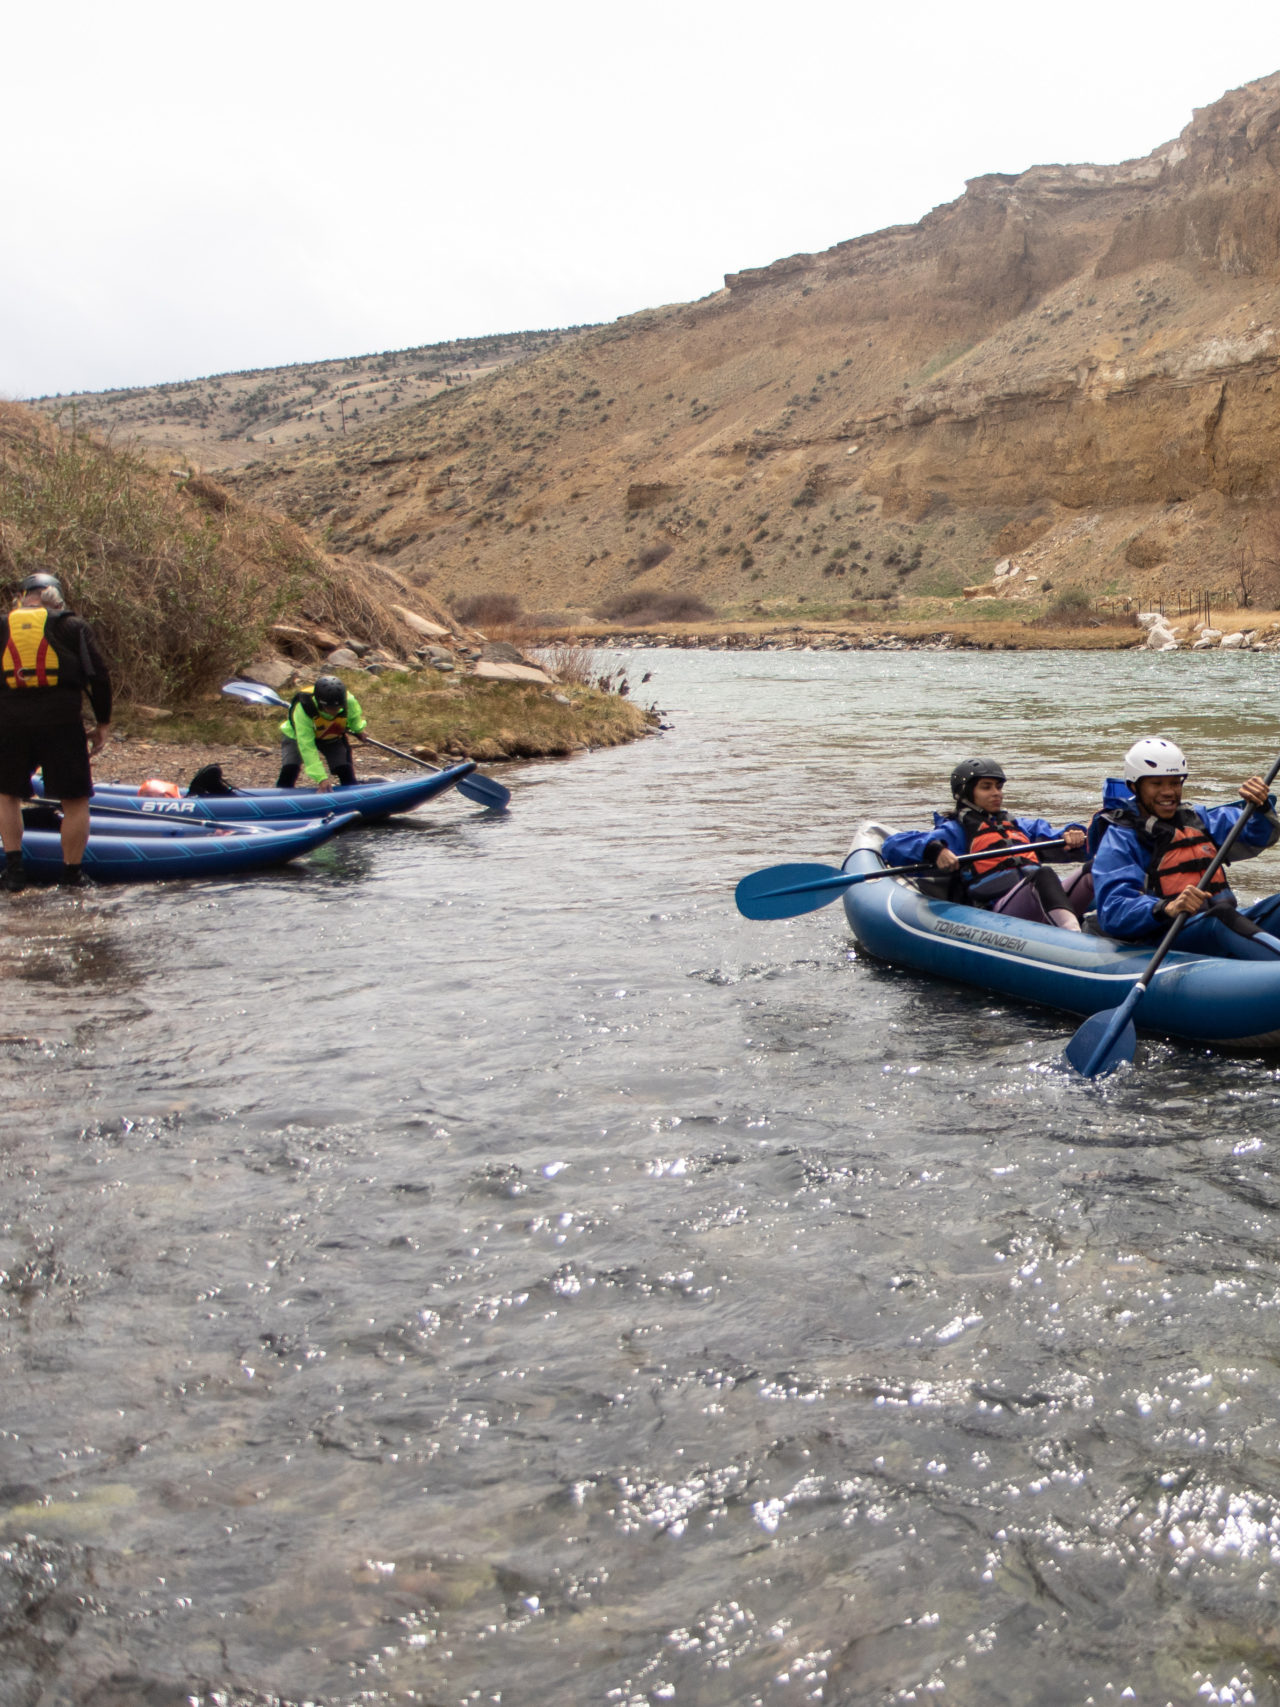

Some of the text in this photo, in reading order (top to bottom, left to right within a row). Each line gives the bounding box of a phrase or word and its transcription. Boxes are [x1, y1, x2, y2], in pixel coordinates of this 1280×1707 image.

[141, 801, 196, 813] STAR
[934, 920, 1028, 952] TOMCAT TANDEM
